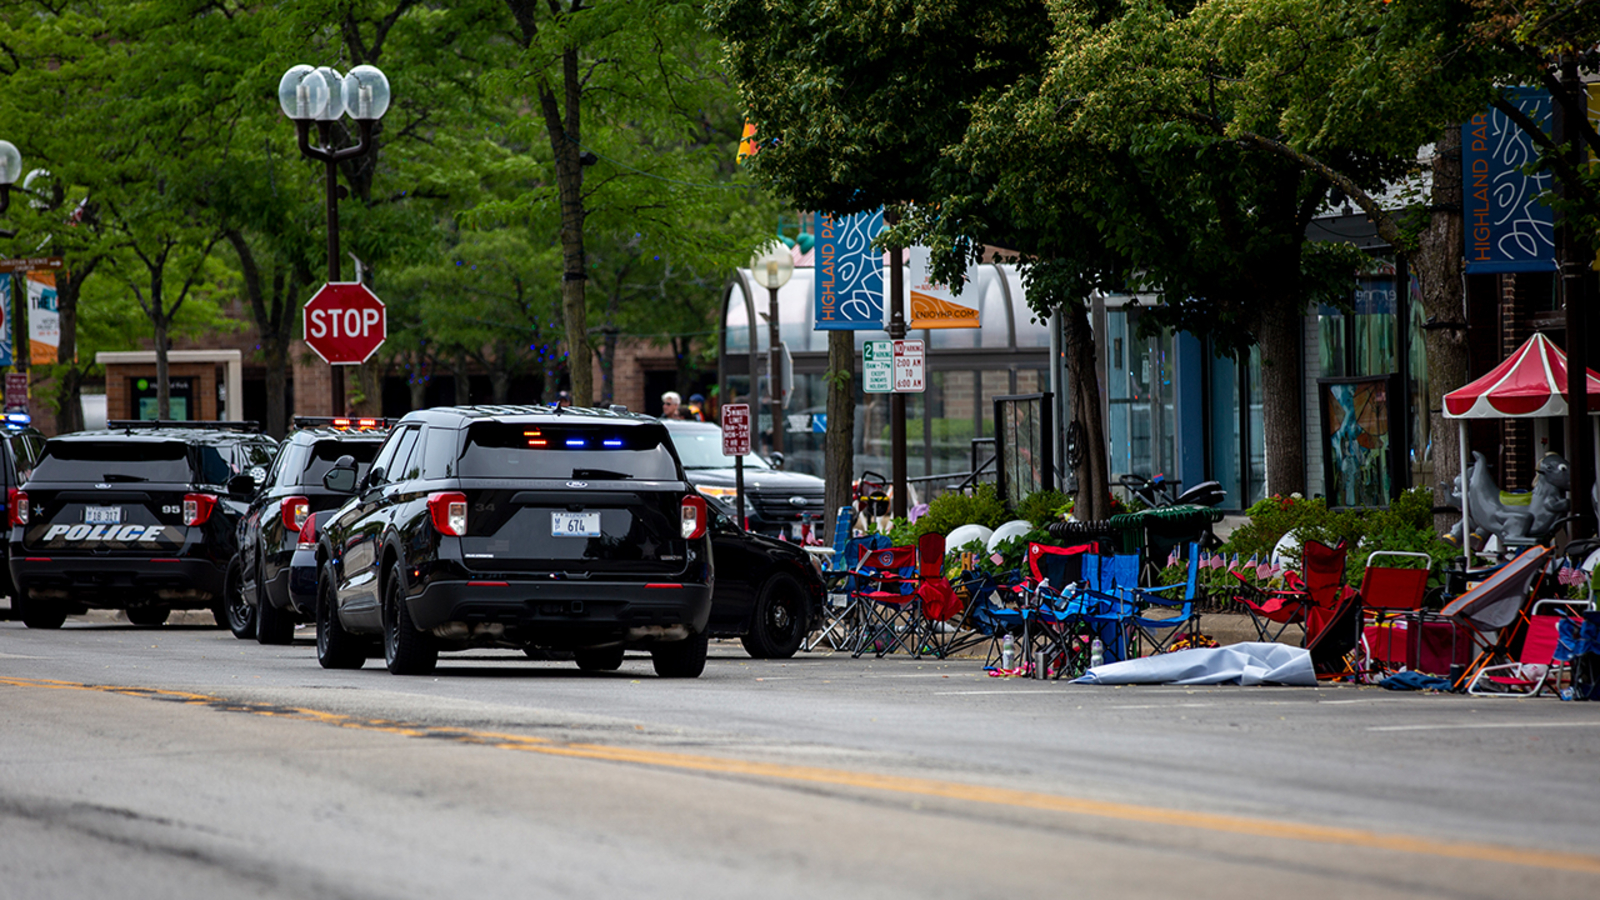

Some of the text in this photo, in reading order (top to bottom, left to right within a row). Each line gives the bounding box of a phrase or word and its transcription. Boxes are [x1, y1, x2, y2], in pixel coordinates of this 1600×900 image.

[1473, 159, 1491, 260] HIGHLAND
[821, 243, 836, 321] HIGHLAND
[915, 309, 975, 321] ENJOYHP.COM
[310, 308, 380, 338] STOP
[865, 344, 872, 358] 2
[895, 344, 904, 353] NO
[897, 359, 922, 367] 2:00 AM
[905, 369, 914, 377] TO
[897, 379, 922, 388] 6:00 AM
[161, 505, 181, 514] 95
[474, 503, 496, 512] 34
[567, 519, 586, 532] 674
[42, 524, 166, 541] POLICE
